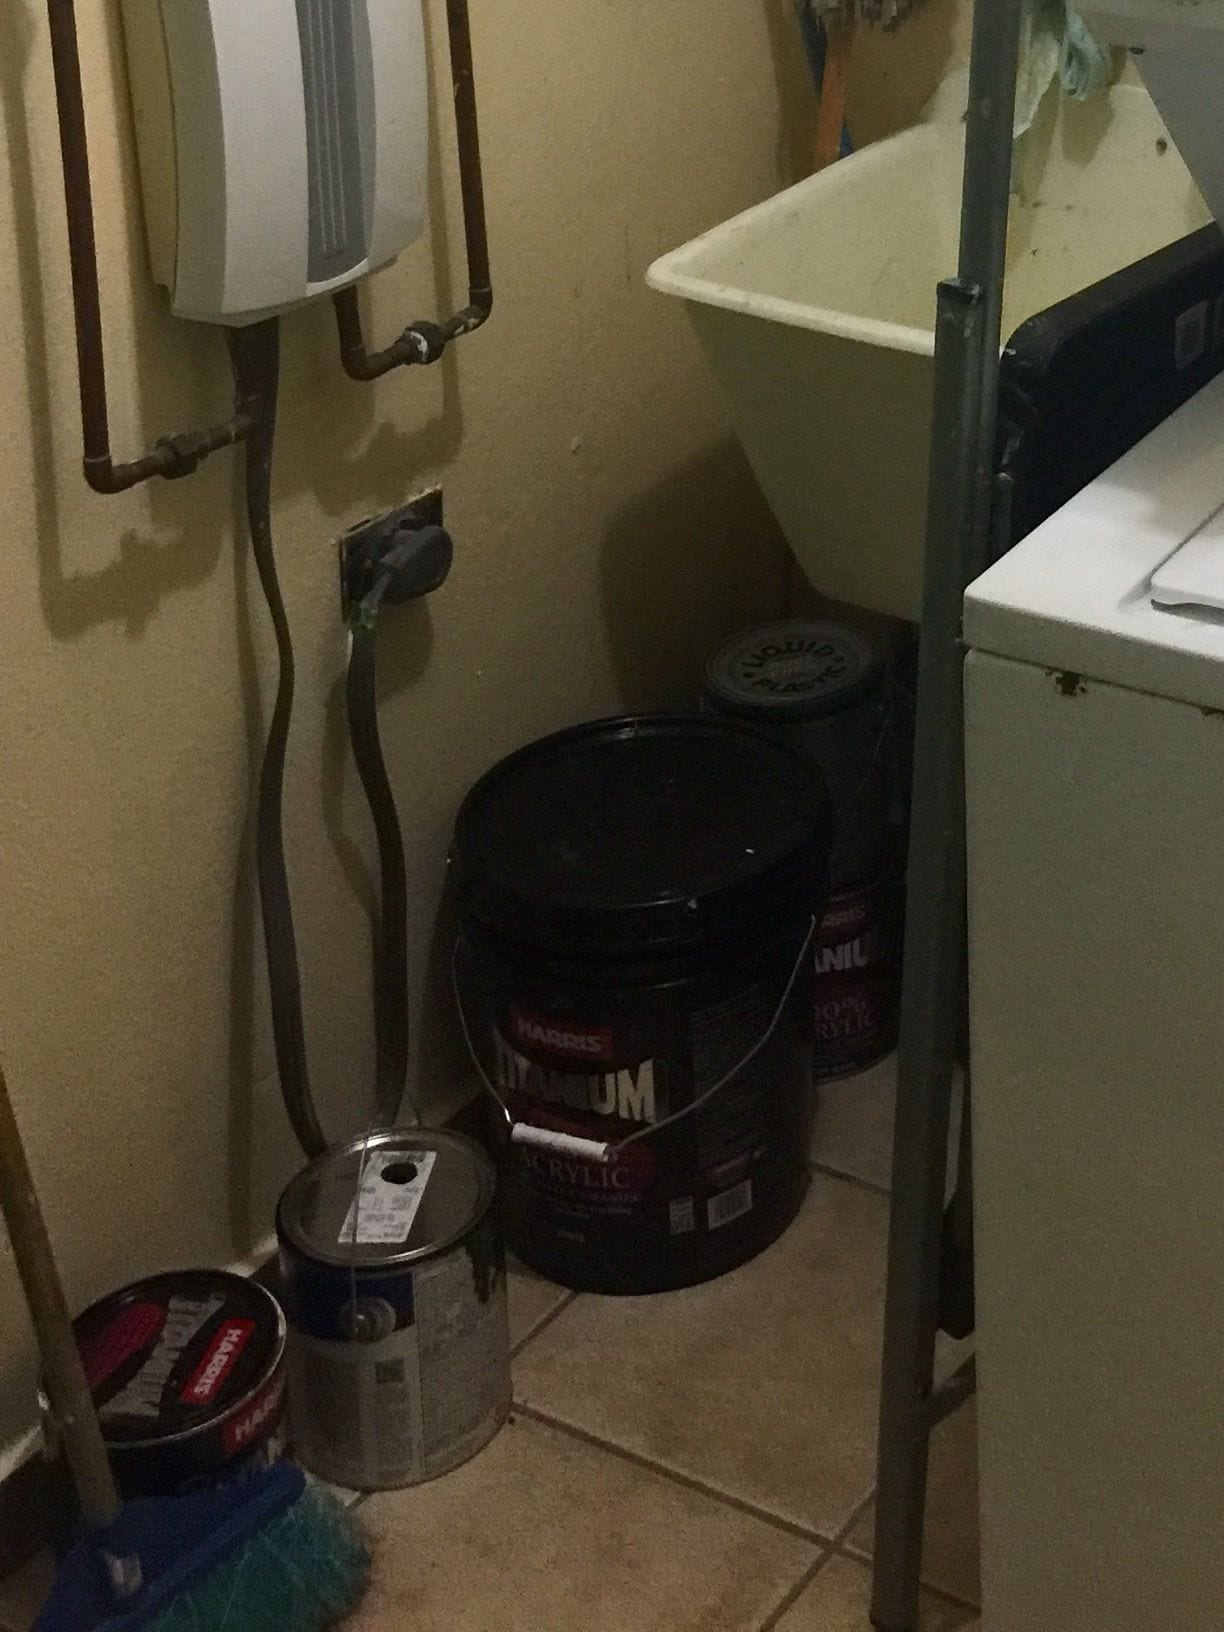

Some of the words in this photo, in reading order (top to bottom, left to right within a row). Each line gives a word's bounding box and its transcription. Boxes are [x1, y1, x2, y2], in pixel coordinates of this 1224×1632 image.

[741, 640, 836, 669] LIQUID
[517, 1017, 603, 1054] HARRIS
[193, 1327, 243, 1396] HARRIS
